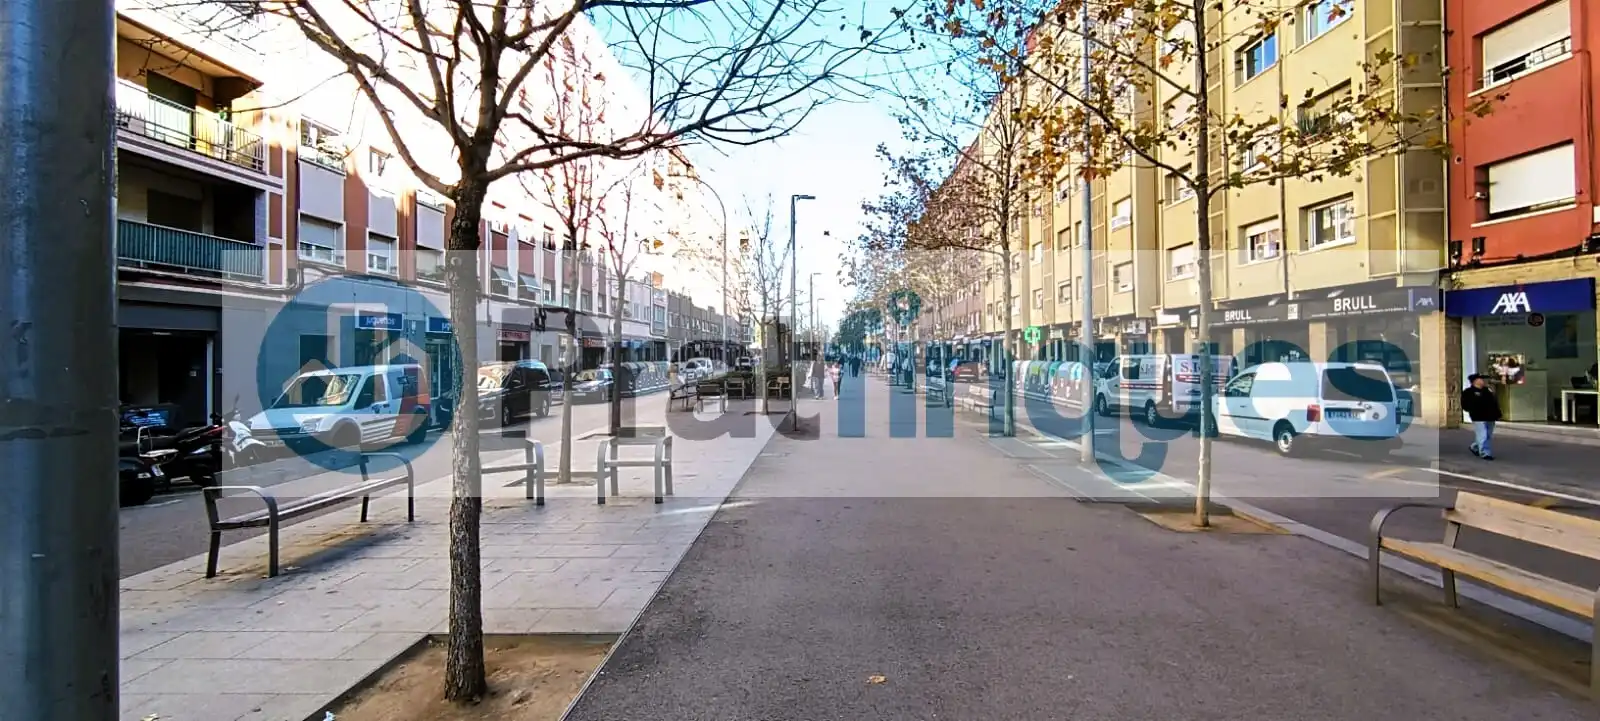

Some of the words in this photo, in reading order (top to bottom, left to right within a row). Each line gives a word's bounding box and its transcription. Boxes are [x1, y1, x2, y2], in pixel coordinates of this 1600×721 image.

[1334, 295, 1377, 312] BRULL
[1490, 291, 1531, 314] AXA
[1224, 309, 1252, 321] BRULL
